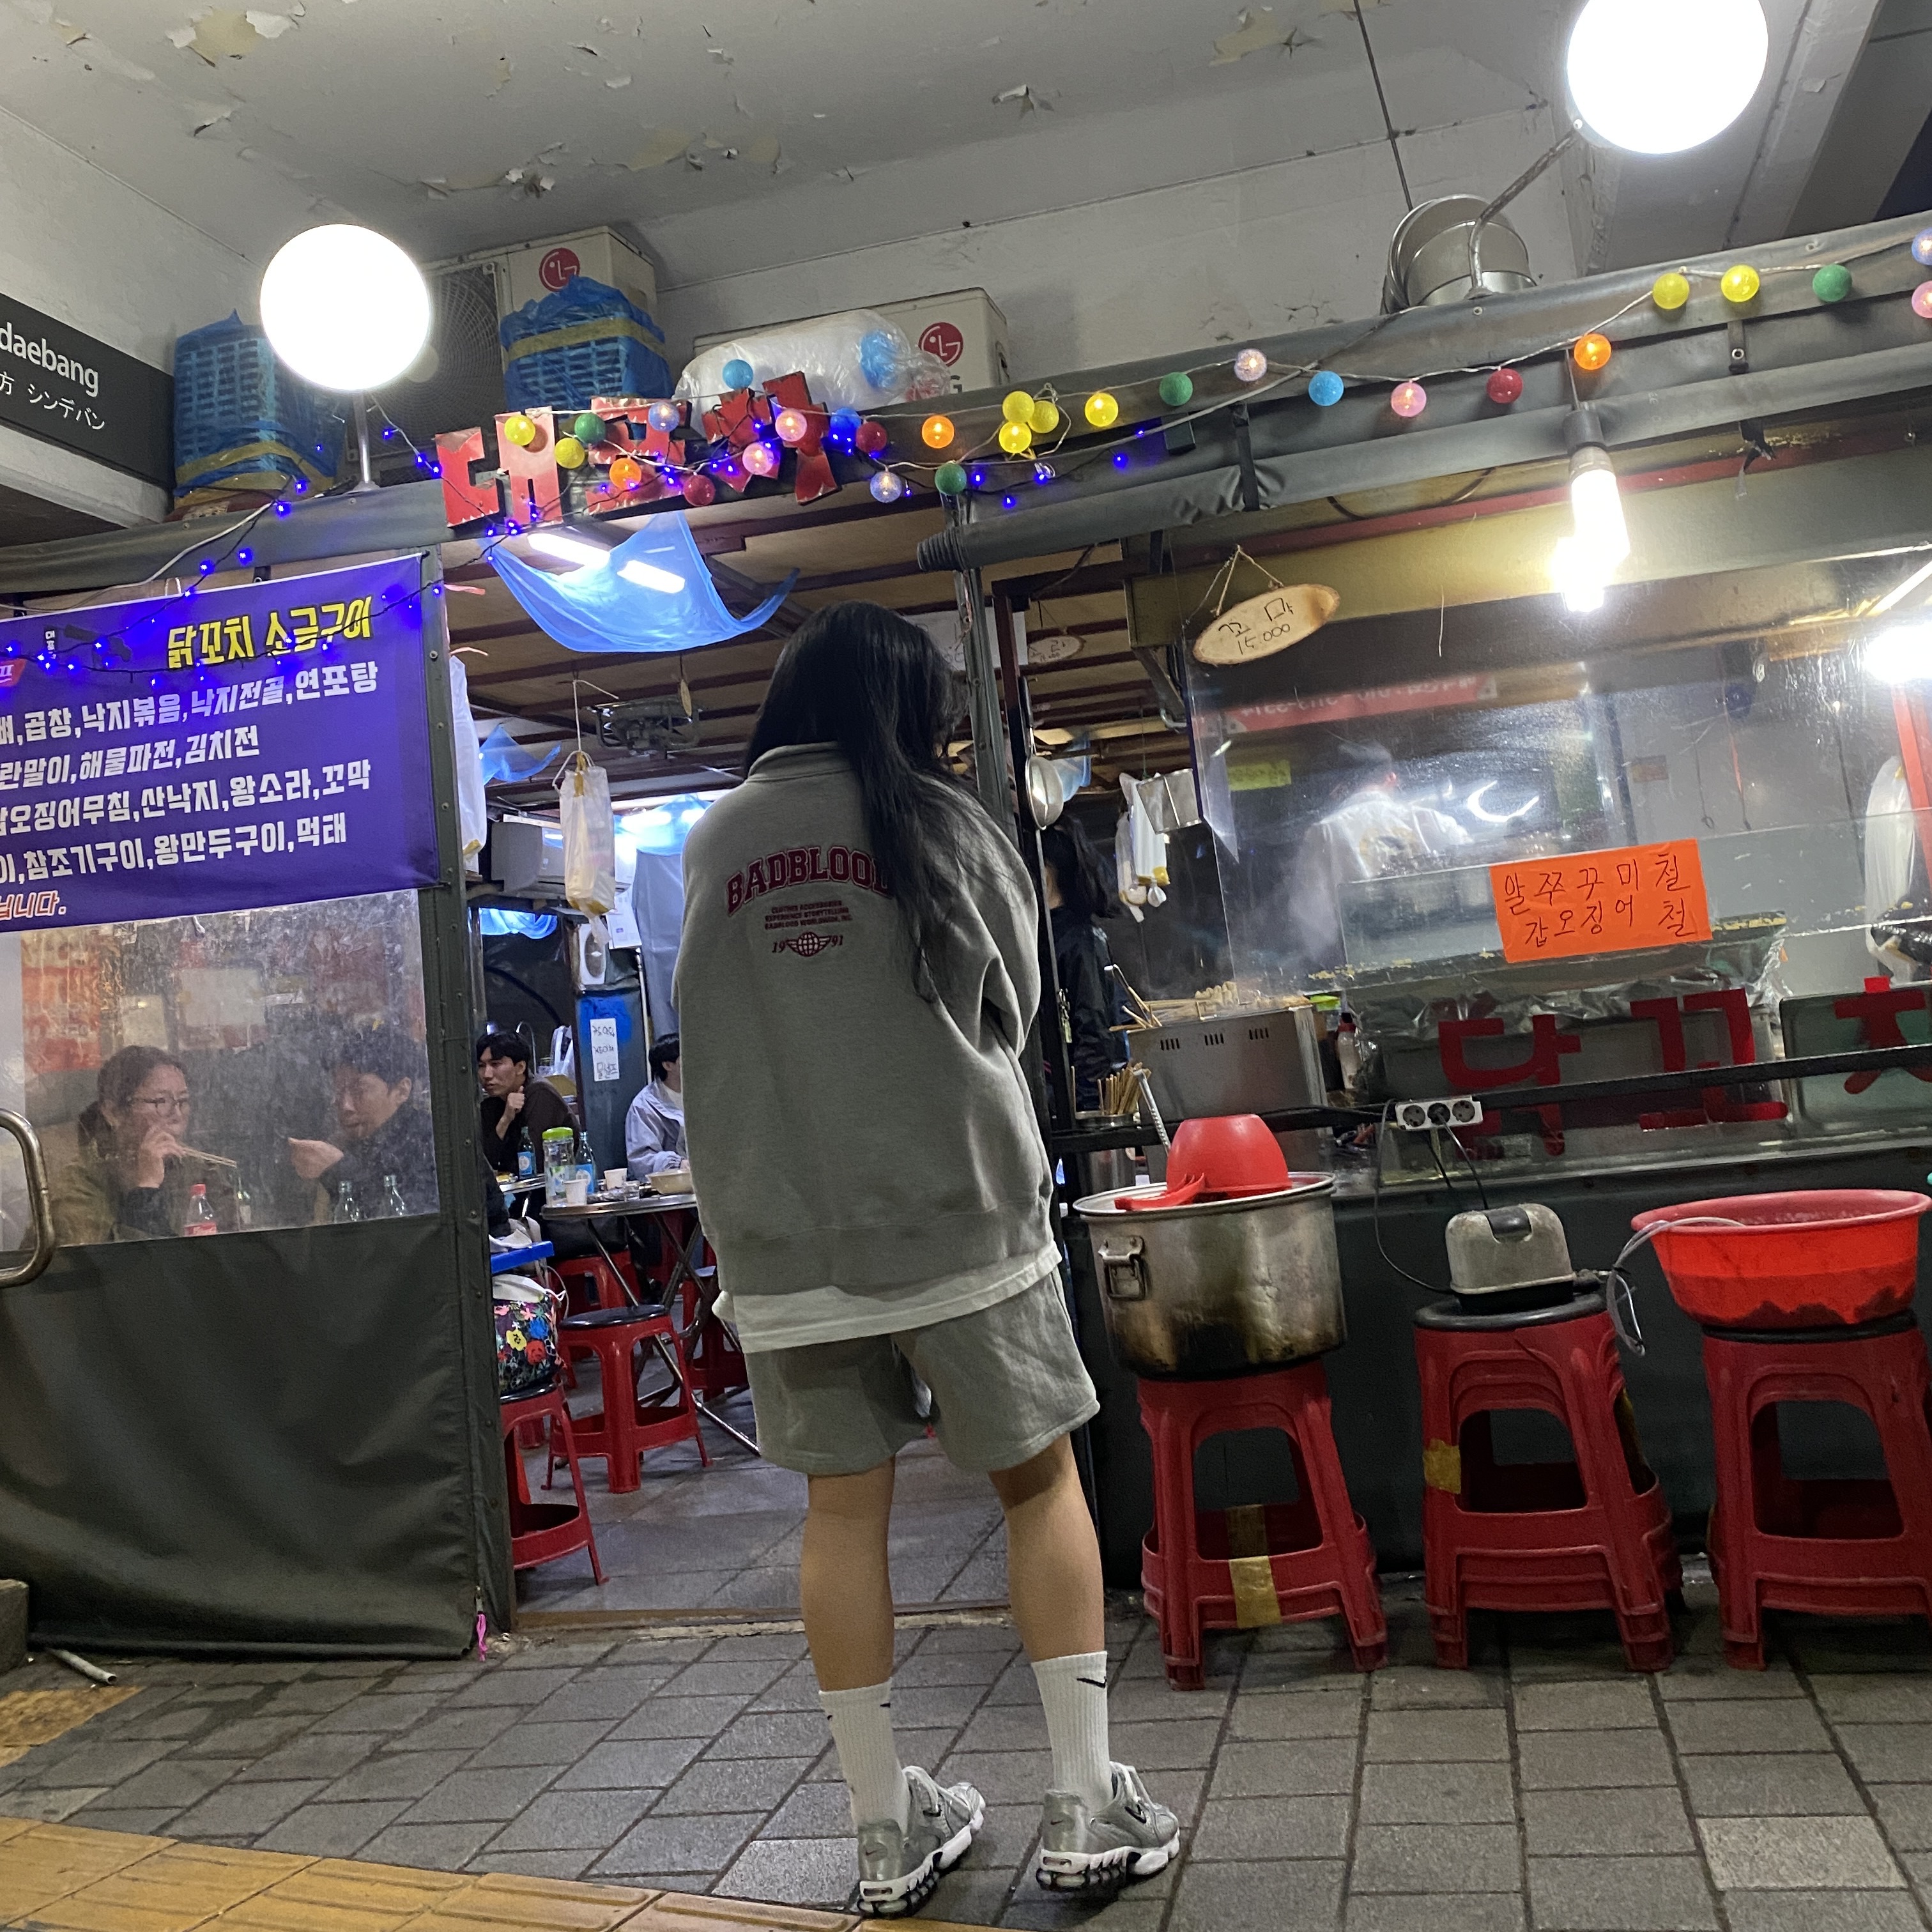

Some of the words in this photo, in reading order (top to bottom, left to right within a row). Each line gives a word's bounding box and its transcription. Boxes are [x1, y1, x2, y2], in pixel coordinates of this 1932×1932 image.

[0, 321, 98, 397] daebang
[27, 383, 105, 429] シンデバン
[167, 615, 255, 669] 닭꼬치
[265, 596, 372, 657] 소금구이
